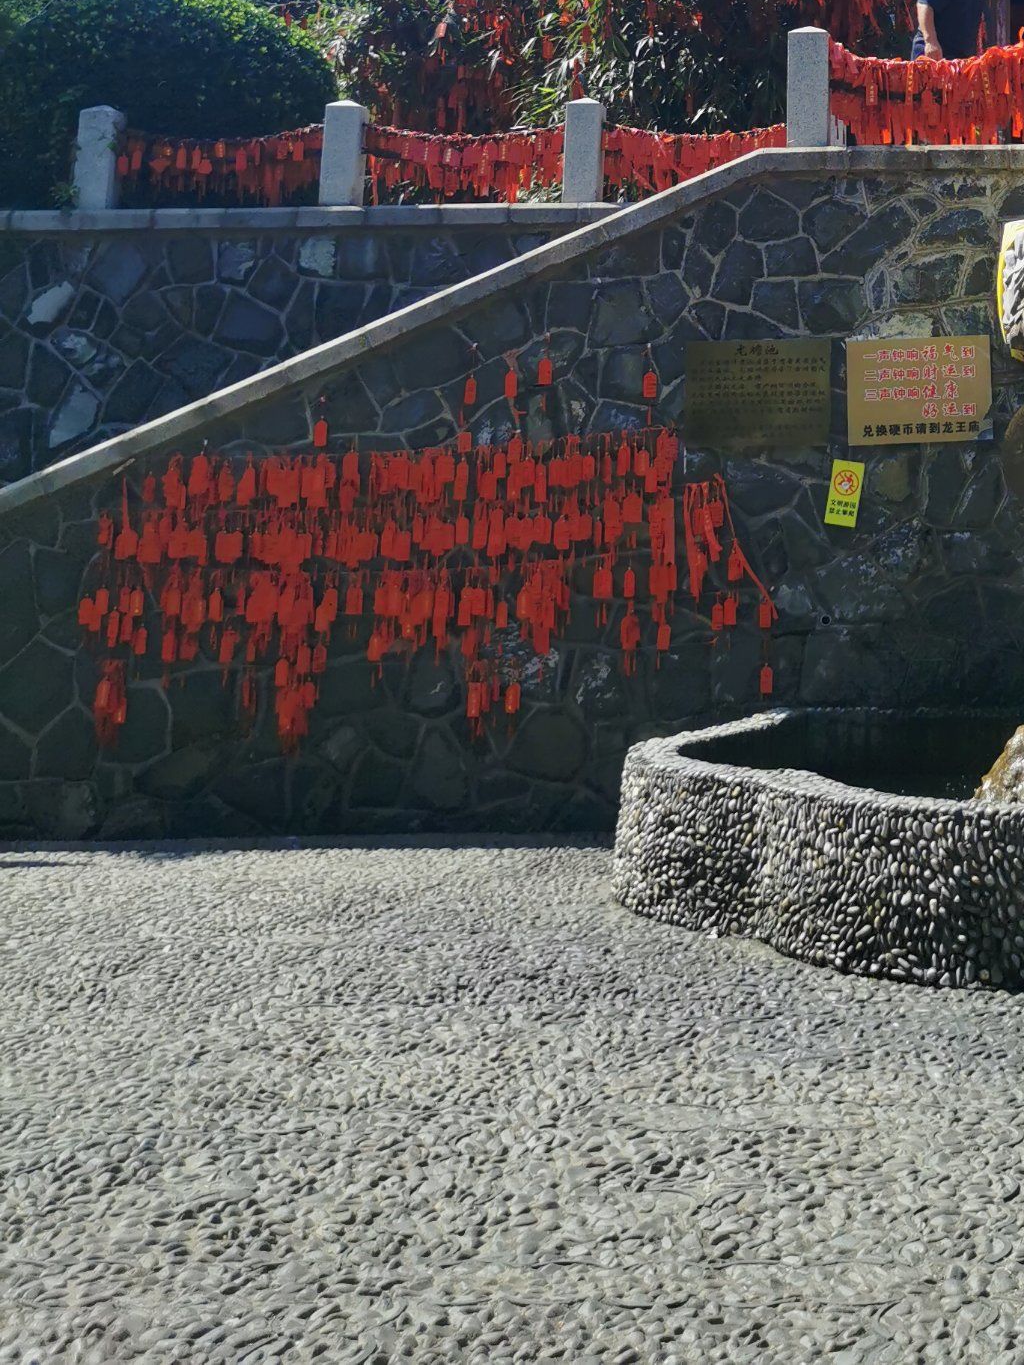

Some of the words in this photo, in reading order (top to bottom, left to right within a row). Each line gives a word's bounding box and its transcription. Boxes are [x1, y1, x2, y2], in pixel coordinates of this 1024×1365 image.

[863, 343, 975, 362] 一声钟响福气到
[864, 363, 976, 382] 二声钟响财运到
[864, 380, 959, 401] 三声钟响健康
[921, 402, 977, 419] 好运到
[862, 420, 980, 438] 兑换硬币请到龙王庙
